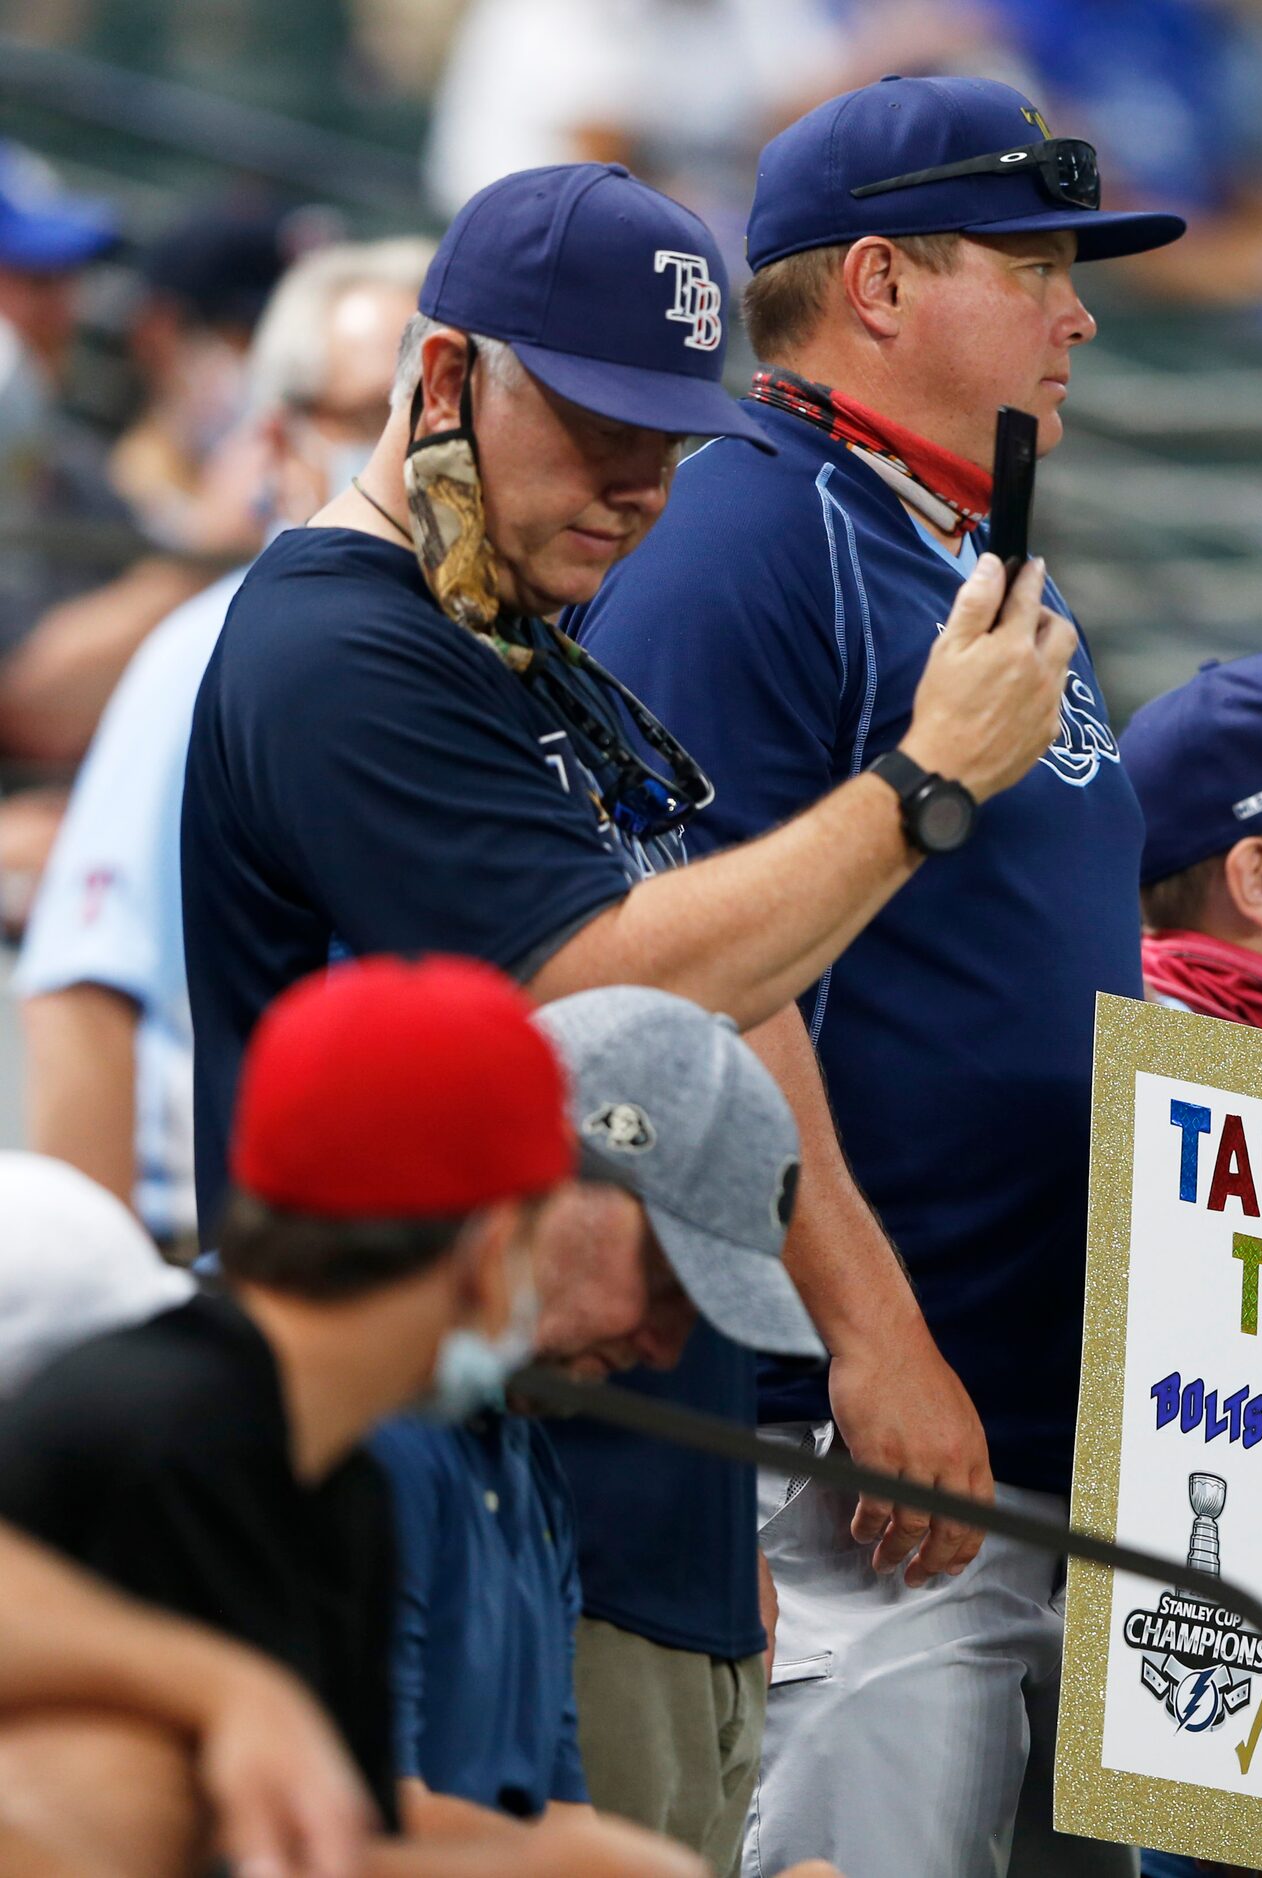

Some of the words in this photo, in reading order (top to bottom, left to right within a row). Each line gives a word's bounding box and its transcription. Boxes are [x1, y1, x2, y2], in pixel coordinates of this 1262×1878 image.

[654, 250, 722, 352] TB
[1159, 1596, 1214, 1622] STANLEY
[1214, 1608, 1241, 1628] CUP
